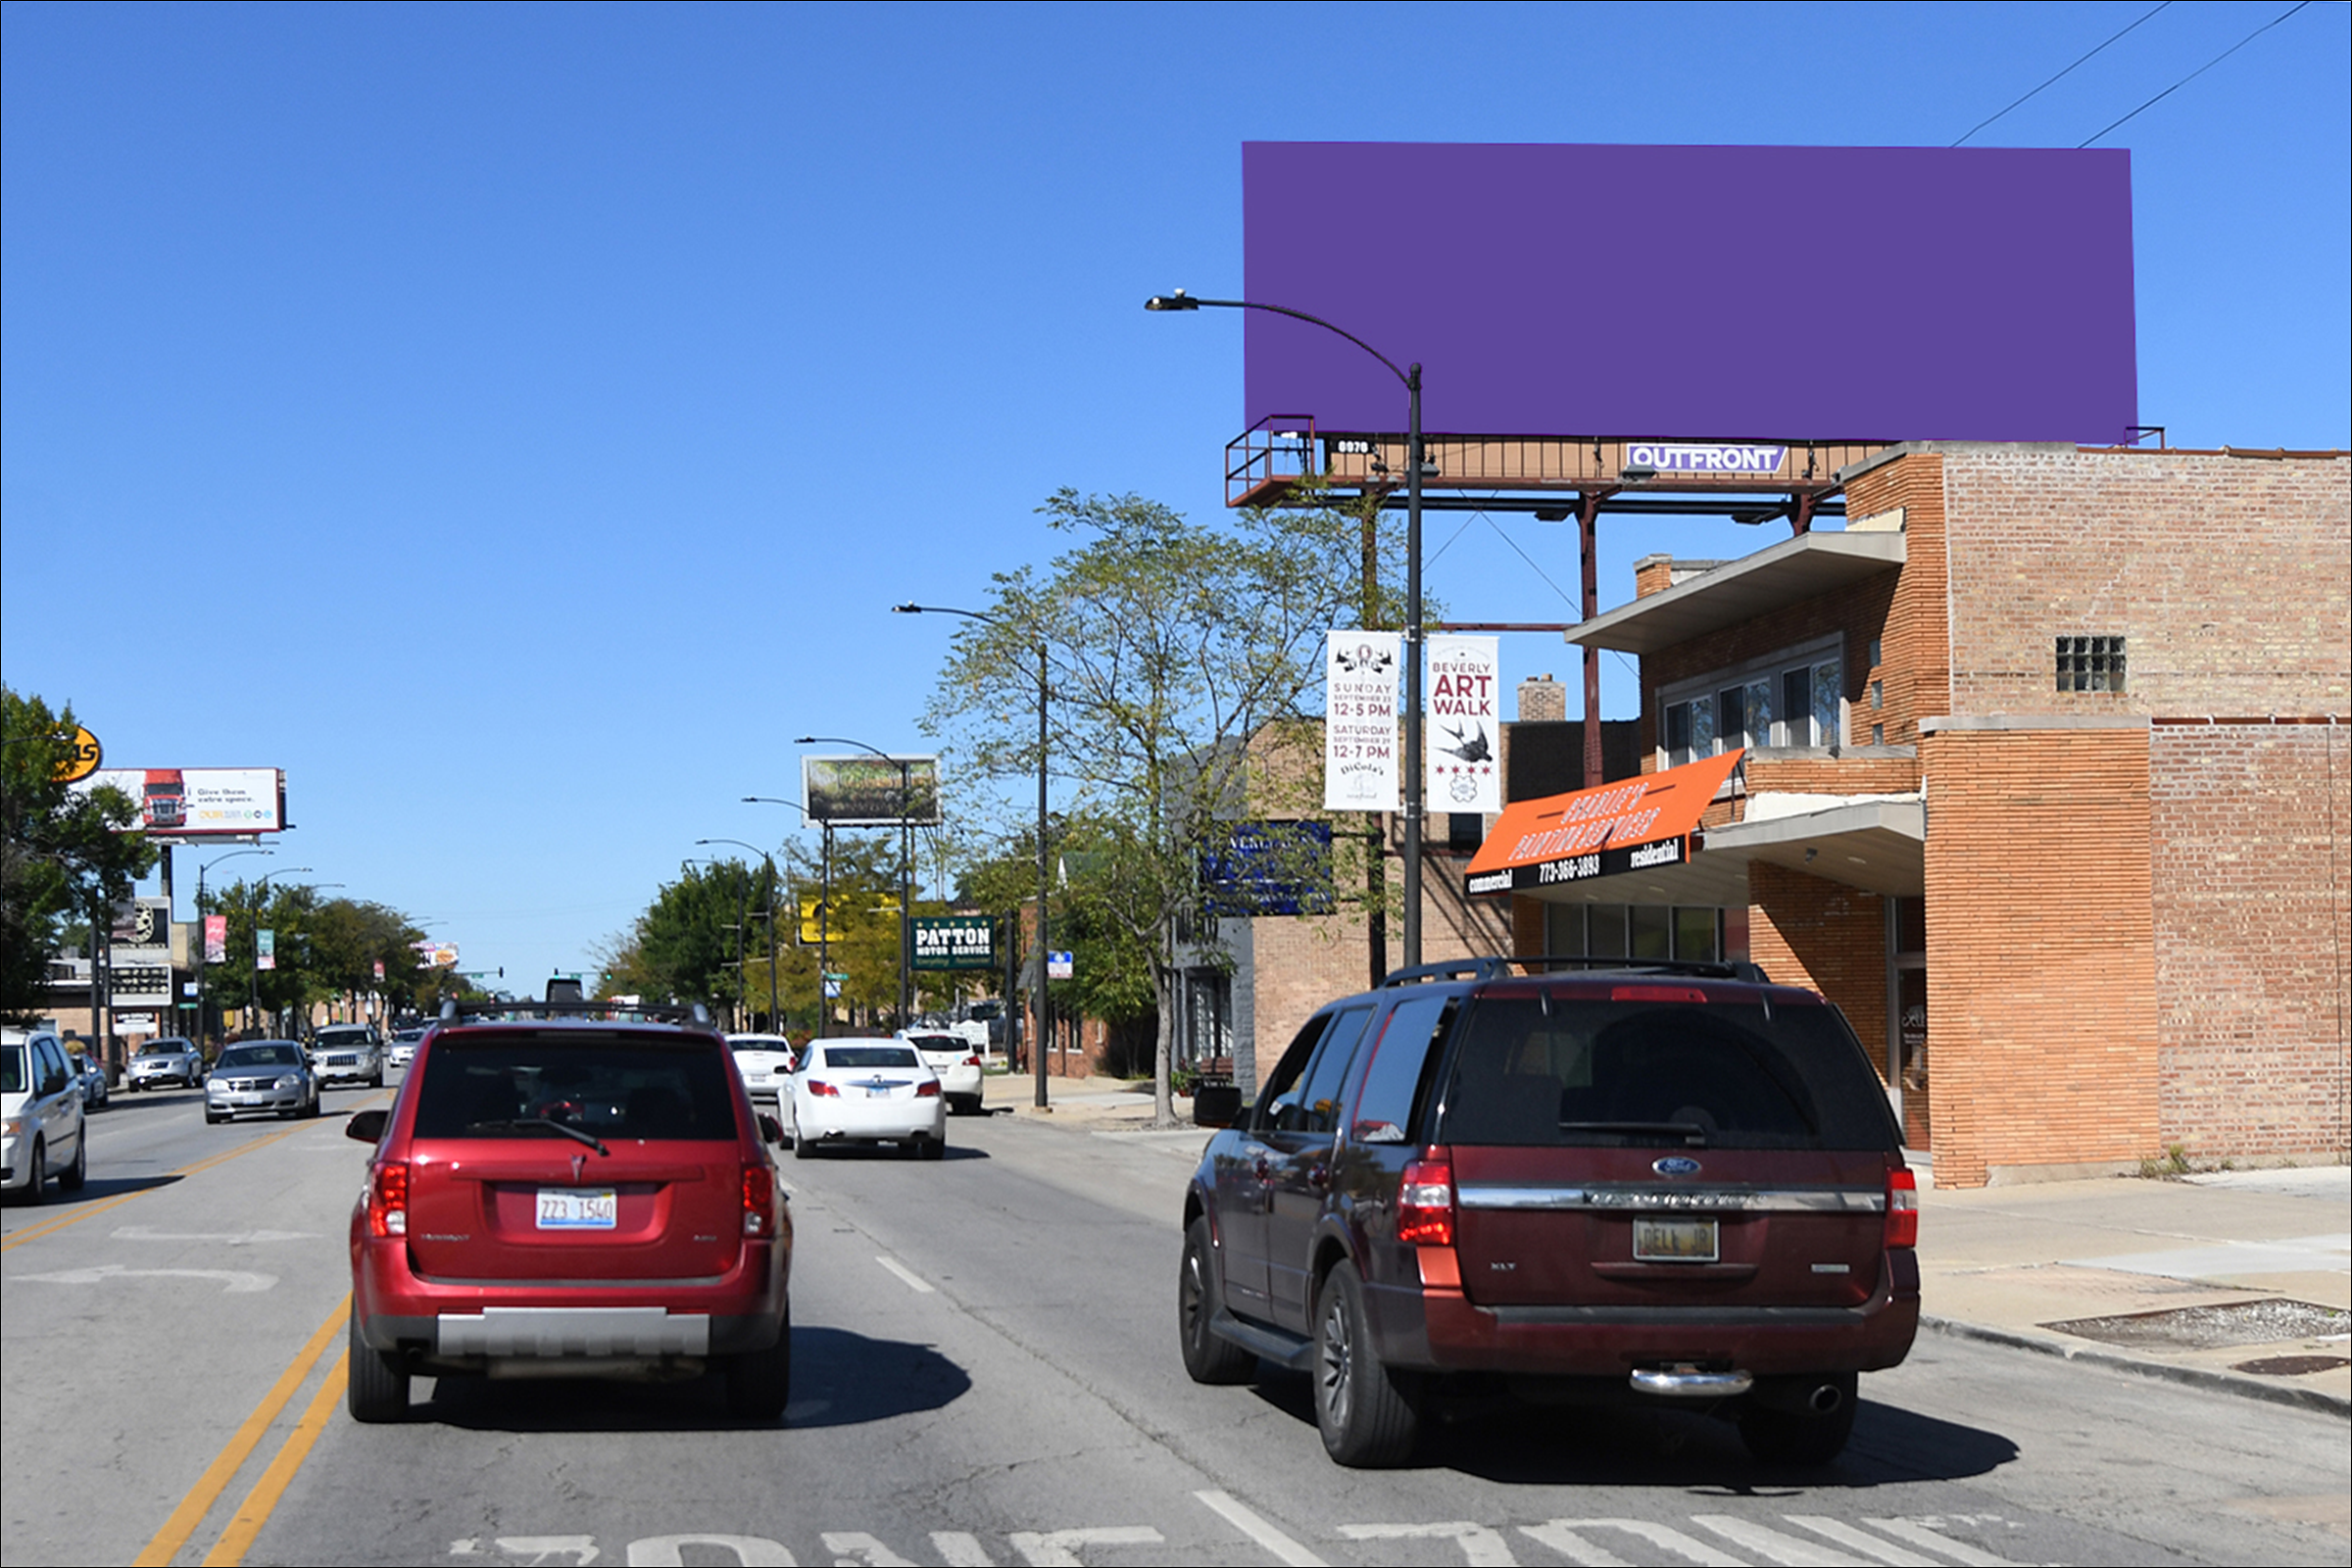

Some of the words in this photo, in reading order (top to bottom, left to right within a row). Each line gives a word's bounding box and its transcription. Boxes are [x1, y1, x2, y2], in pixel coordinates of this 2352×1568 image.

[1633, 446, 1779, 469] OUTFRONT
[1433, 662, 1491, 673] BEVERLY
[1334, 682, 1392, 694] SUNDAY
[1434, 674, 1492, 698] ART
[1334, 694, 1381, 703] SEPTEMBER
[1334, 703, 1364, 716] 12-5
[1368, 703, 1391, 717] PM
[1434, 699, 1492, 716] WALK
[1334, 725, 1392, 736] SATURDAY
[1334, 745, 1362, 758] 12-7
[1366, 746, 1390, 759] PM
[1340, 761, 1384, 775] DiCola's
[1508, 823, 1586, 861] PAINTING
[1577, 807, 1661, 850] SERVICES
[1469, 868, 1513, 893] commercial
[1630, 838, 1680, 868] residential
[916, 928, 990, 946] PATTON
[916, 947, 949, 956] MOTOR
[952, 946, 991, 955] SERVICE
[579, 1199, 613, 1219] 1540
